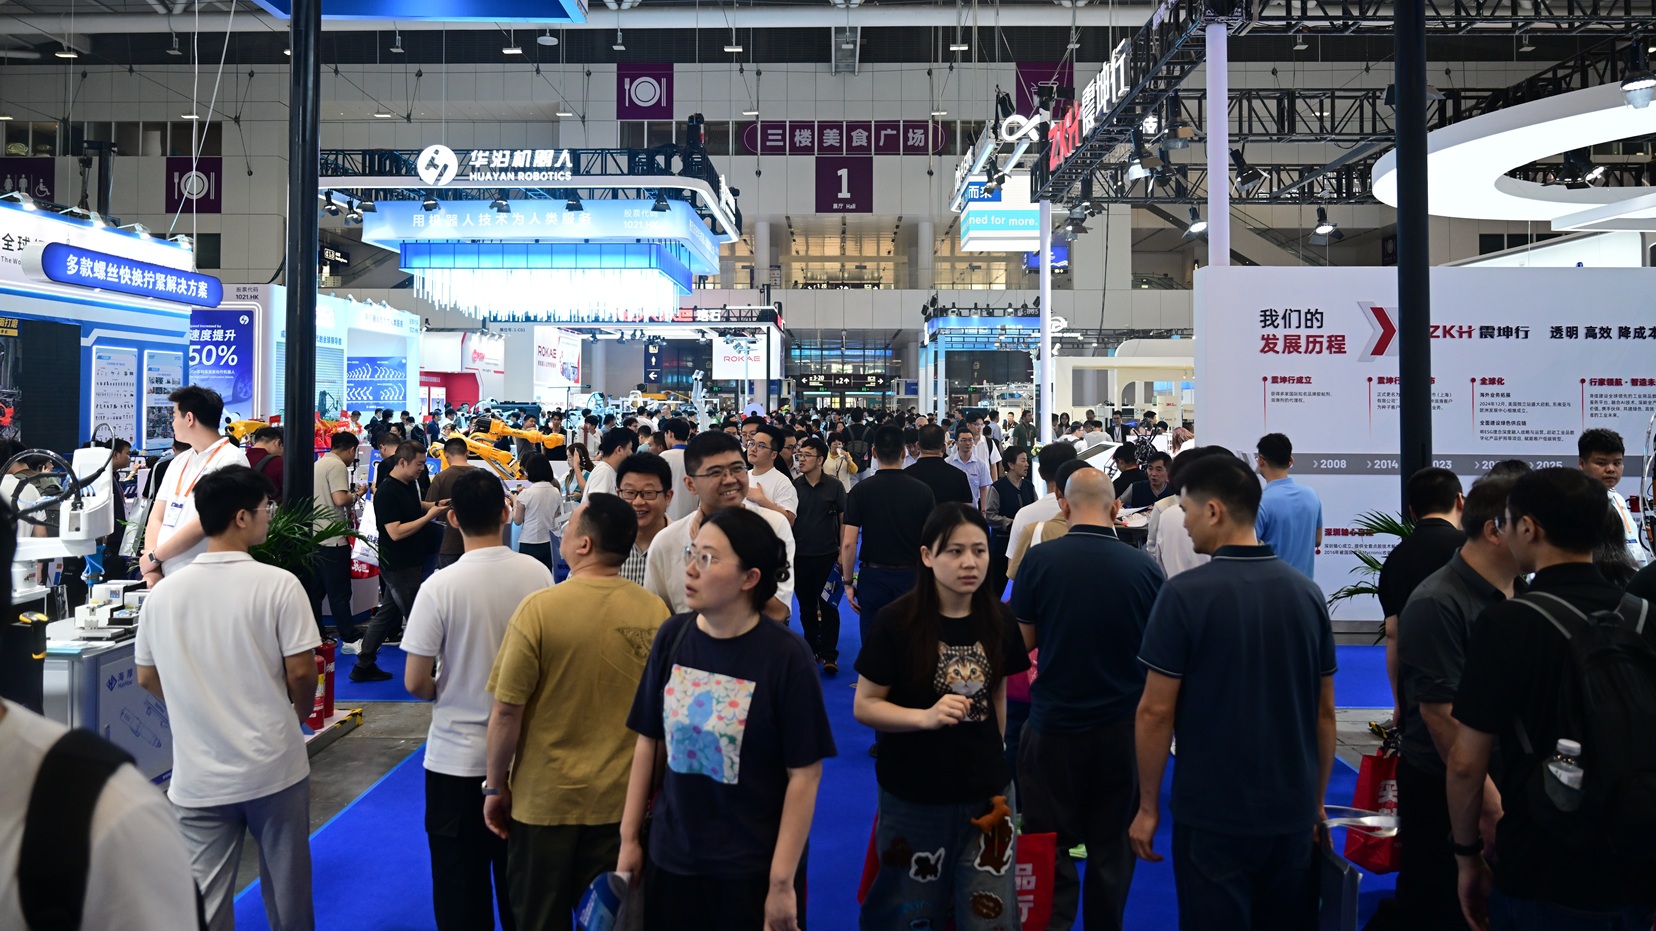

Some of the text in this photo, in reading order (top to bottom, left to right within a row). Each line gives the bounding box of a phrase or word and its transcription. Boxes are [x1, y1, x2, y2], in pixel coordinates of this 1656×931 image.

[766, 128, 925, 148] 三楼美食广场
[1048, 100, 1083, 172] ZKH
[469, 149, 573, 168] 华沿机器人
[469, 171, 573, 181] HUAYAN ROBOTICS
[837, 168, 851, 199] 1
[412, 211, 592, 228] 用机器人技术为人类服务
[991, 215, 1005, 225] for
[1008, 216, 1038, 227] more.
[66, 254, 208, 299] 多款螺丝快换拧紧解决方案
[1259, 308, 1324, 329] 我们的
[189, 329, 236, 342] 速度提升
[1430, 325, 1530, 340] ZKH 震坤行
[1550, 325, 1579, 340] 透明
[1585, 325, 1612, 340] 高效
[538, 345, 557, 359] ROKAE
[1259, 334, 1347, 355] 发展历程
[189, 345, 238, 367] 50%
[1270, 375, 1312, 385] 震坤行成立
[1479, 377, 1505, 386] 全球化
[1320, 459, 1347, 469] 2008
[1374, 459, 1399, 469] 2014
[1432, 460, 1452, 469] 023
